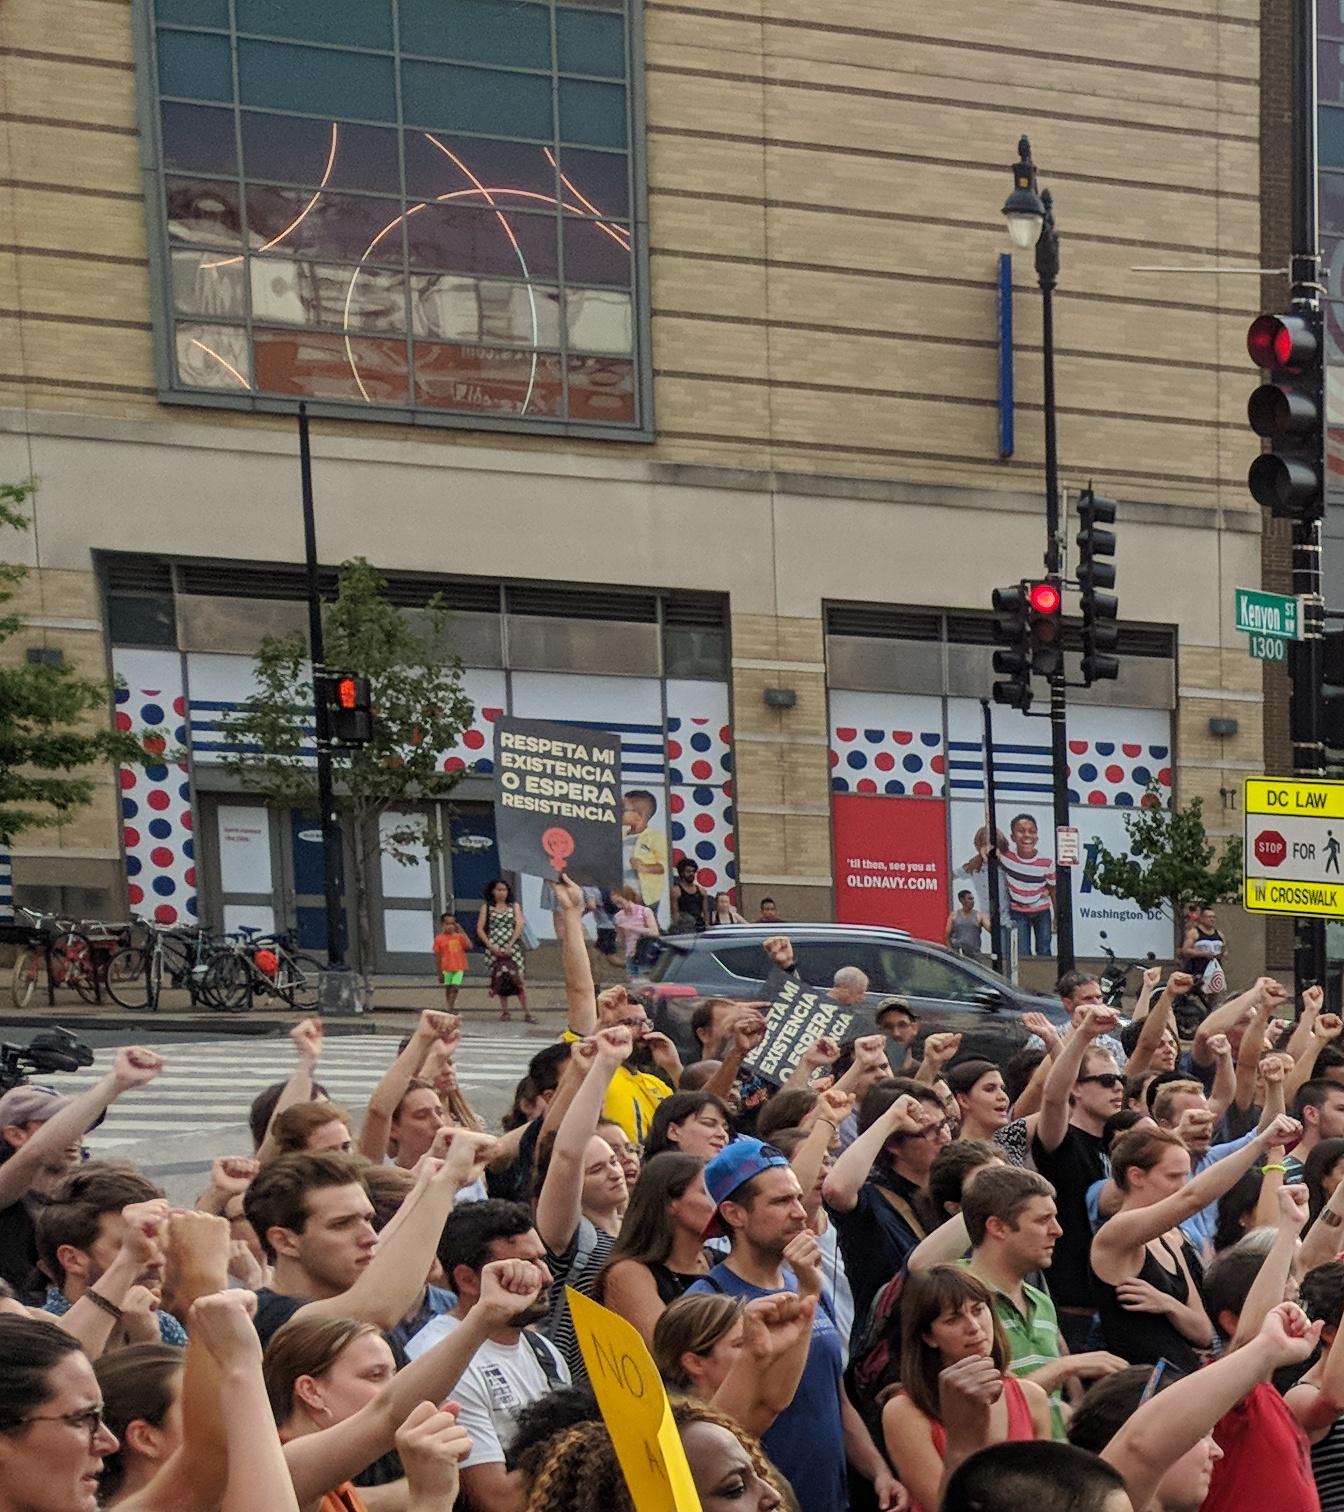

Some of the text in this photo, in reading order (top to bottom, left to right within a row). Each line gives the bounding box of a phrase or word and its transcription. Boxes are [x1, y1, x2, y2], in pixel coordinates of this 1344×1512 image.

[1240, 595, 1280, 635] Kenyon
[1252, 636, 1284, 660] 1300
[501, 731, 615, 766] RESPETA MI
[501, 752, 616, 785] EXISTENCIA
[501, 771, 616, 806] O ESPERA
[1267, 790, 1328, 809] DC LAW
[501, 792, 617, 824] RESISTENCIA
[1258, 841, 1316, 860] STOP FOR
[865, 859, 887, 872] then,
[888, 861, 905, 872] see
[905, 863, 923, 874] you
[924, 862, 936, 872] at
[846, 875, 938, 892] OLDNAVY.COM
[1254, 885, 1338, 907] IN CROSSWALK
[1079, 906, 1163, 923] Washington DC
[778, 980, 800, 1002] MI
[759, 992, 819, 1075] EXISTENCIA
[590, 1331, 645, 1399] NO
